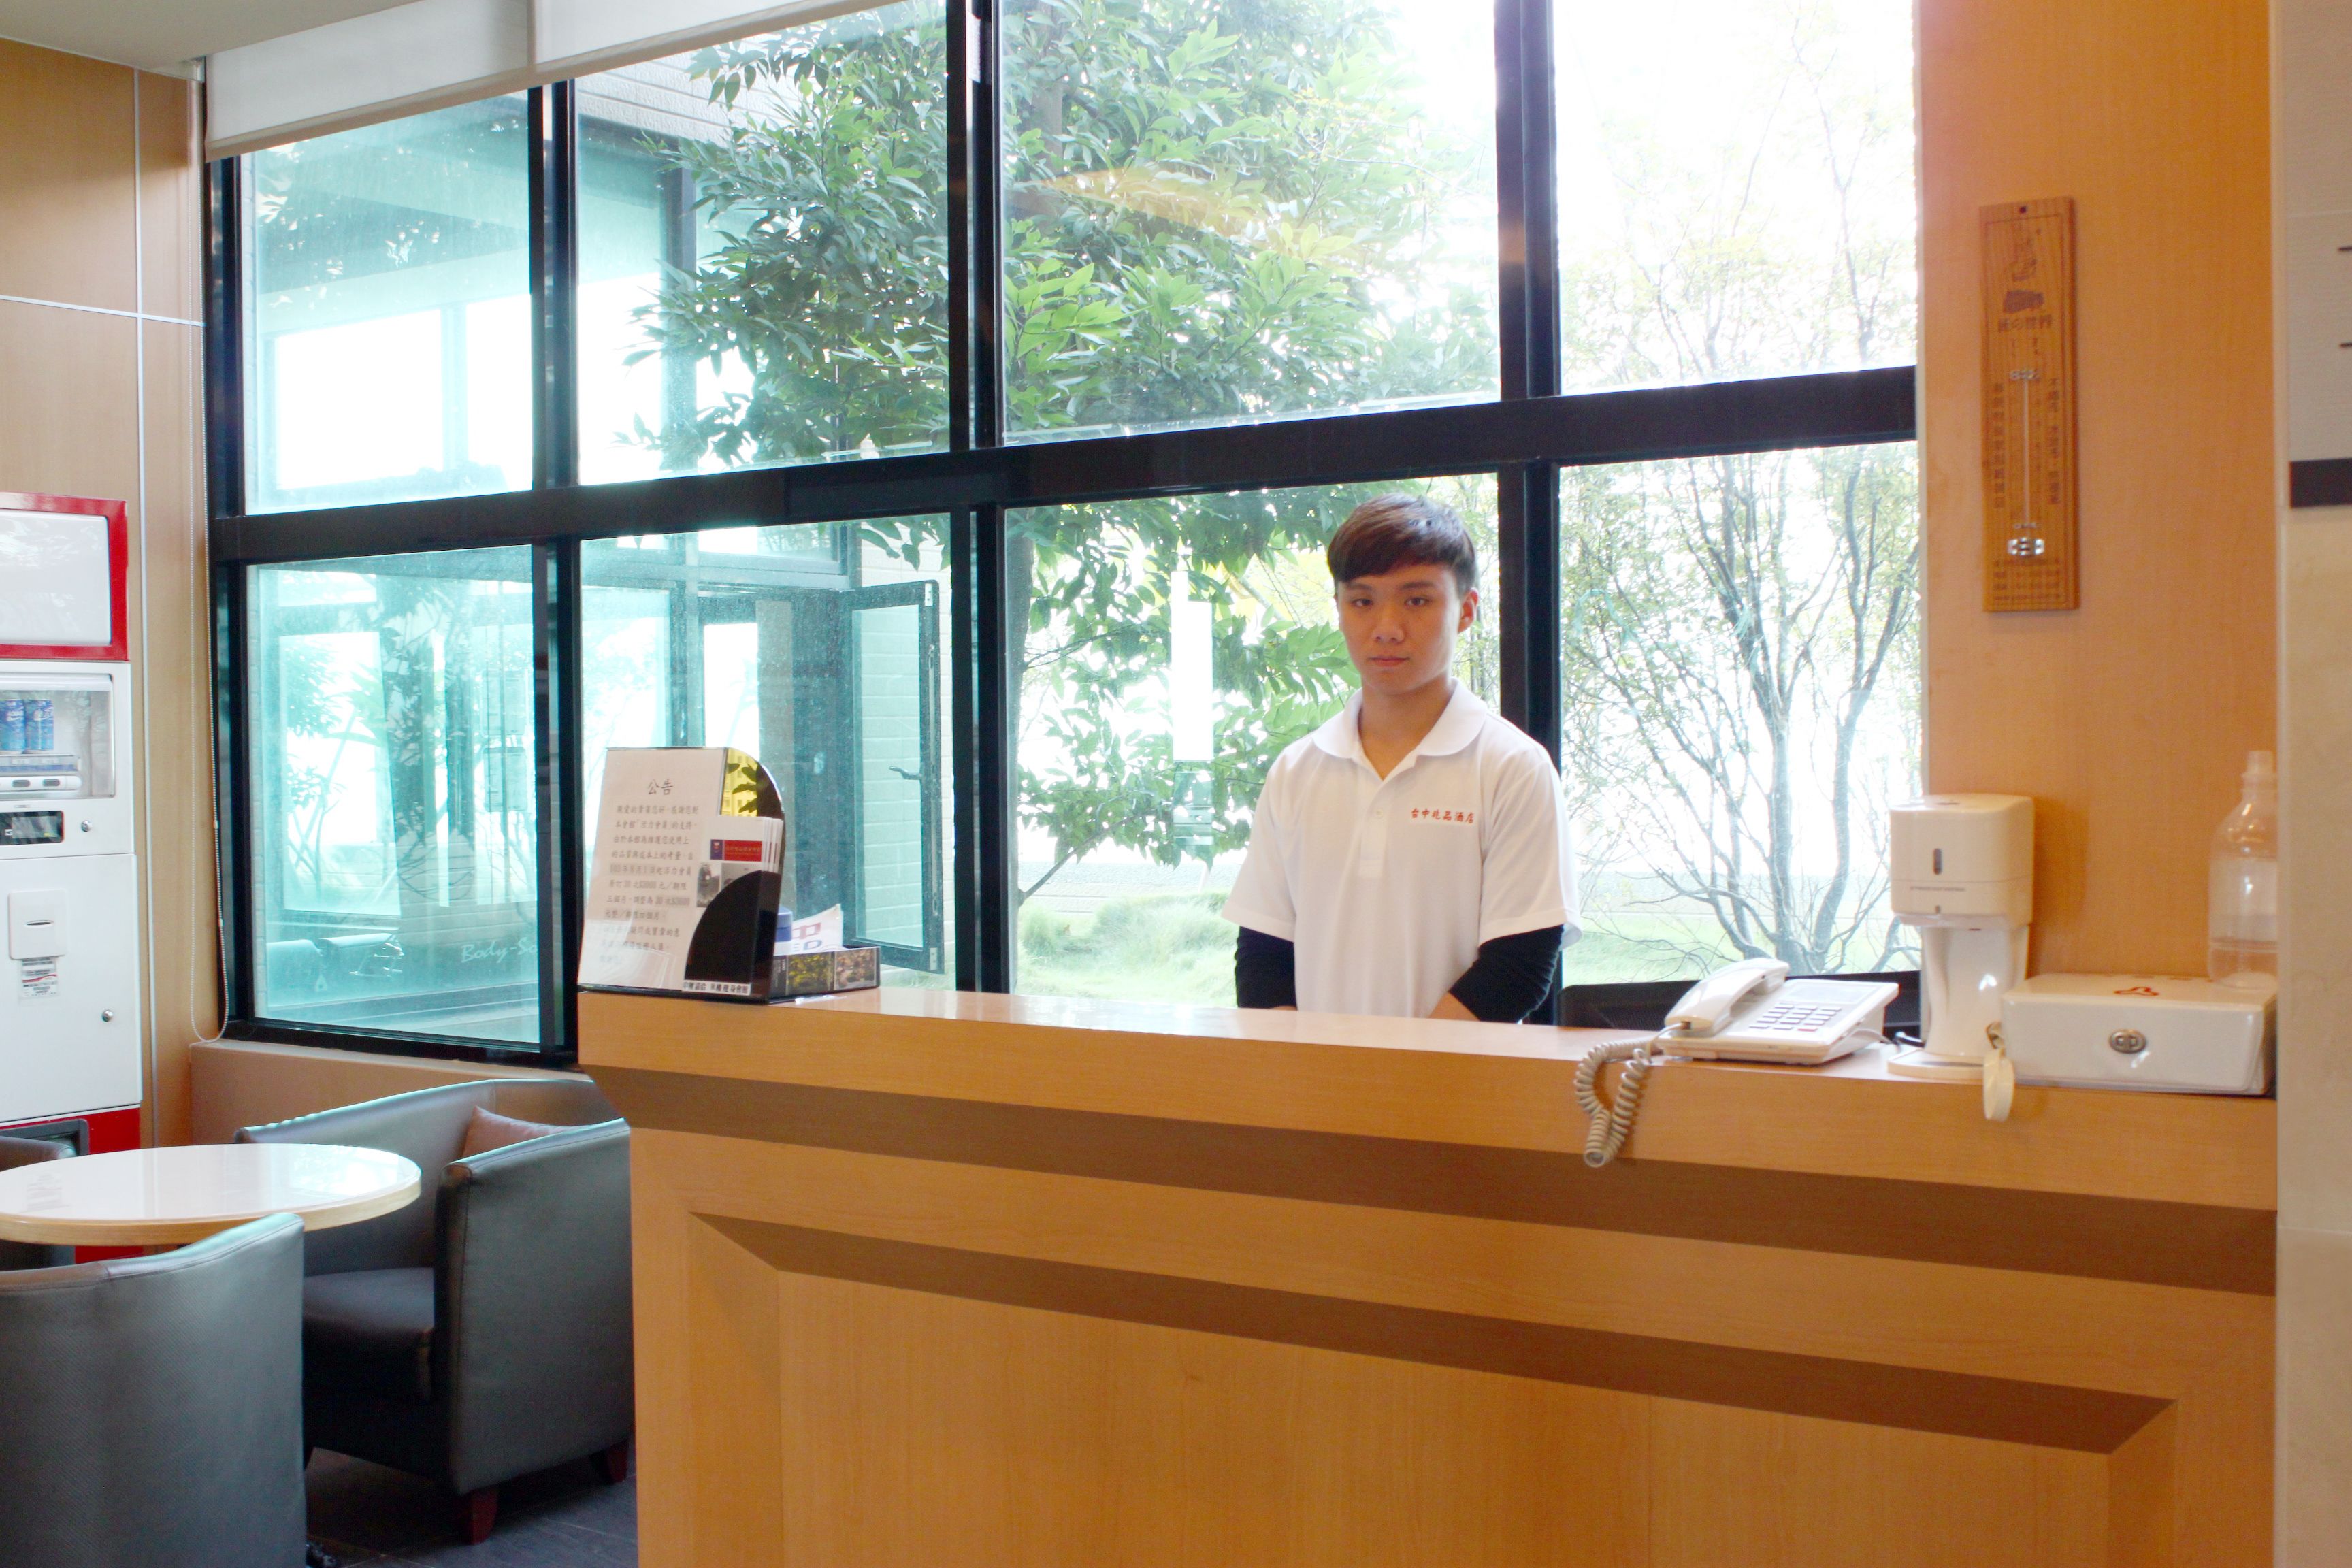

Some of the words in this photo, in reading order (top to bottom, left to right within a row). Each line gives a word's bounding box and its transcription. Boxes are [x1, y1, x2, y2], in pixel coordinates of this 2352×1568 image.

[648, 778, 674, 795] 公告
[1411, 807, 1475, 823] 台中兆品酒店
